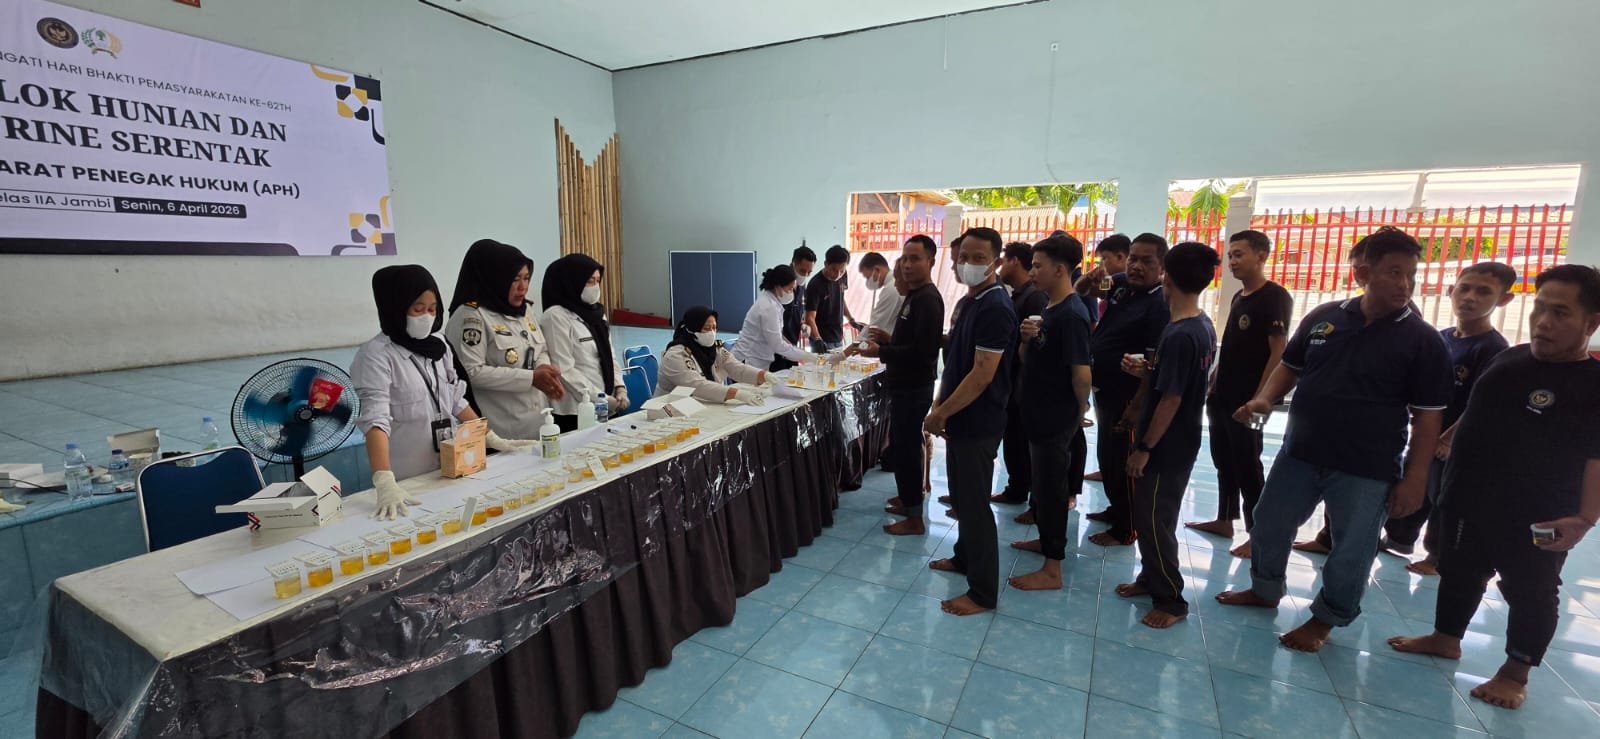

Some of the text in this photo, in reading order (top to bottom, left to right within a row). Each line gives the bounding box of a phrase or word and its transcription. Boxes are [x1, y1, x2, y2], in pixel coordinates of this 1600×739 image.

[0, 51, 292, 112] GATI HARI BHAKTI PEMASYARAKATAN KE-62TH
[0, 79, 287, 142] LOK HUNIAN DAN
[1, 115, 272, 168] RINE SERENTAK
[35, 195, 56, 206] IIA
[60, 196, 111, 208] Jambi
[72, 166, 175, 187] PENEGAK
[180, 176, 249, 193] HUKUM
[253, 180, 301, 199] (APH)
[121, 200, 240, 215] Senin, 6 April 2026
